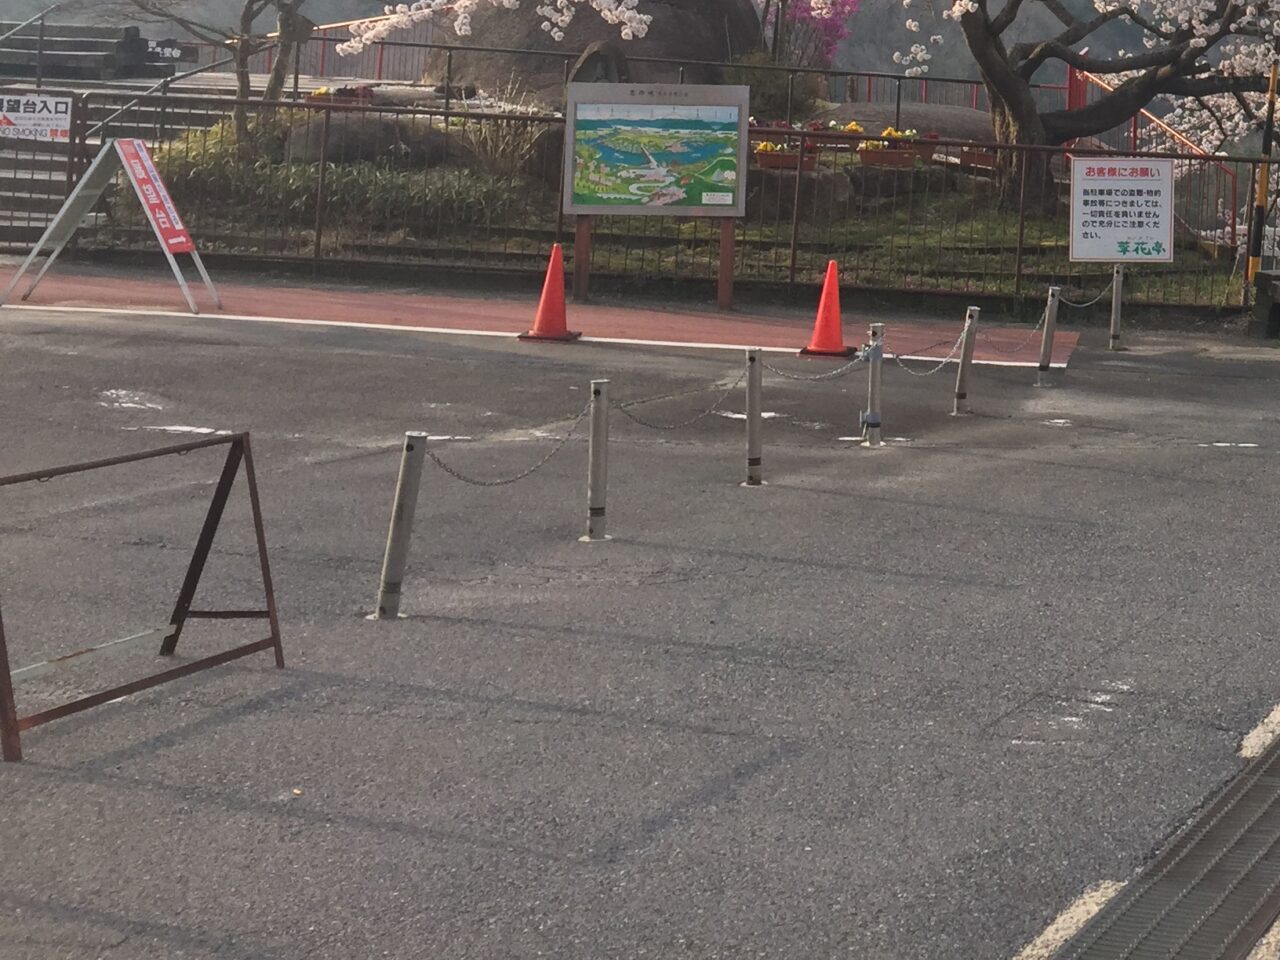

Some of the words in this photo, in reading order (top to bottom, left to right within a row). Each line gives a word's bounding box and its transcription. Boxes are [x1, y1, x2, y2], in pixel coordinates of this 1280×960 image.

[0, 99, 68, 114] 望台入口
[12, 128, 48, 137] SMOKING
[1085, 167, 1161, 178] お客様にお願い
[1082, 210, 1160, 218] 一切責任を負いません
[1081, 231, 1102, 239] さい。
